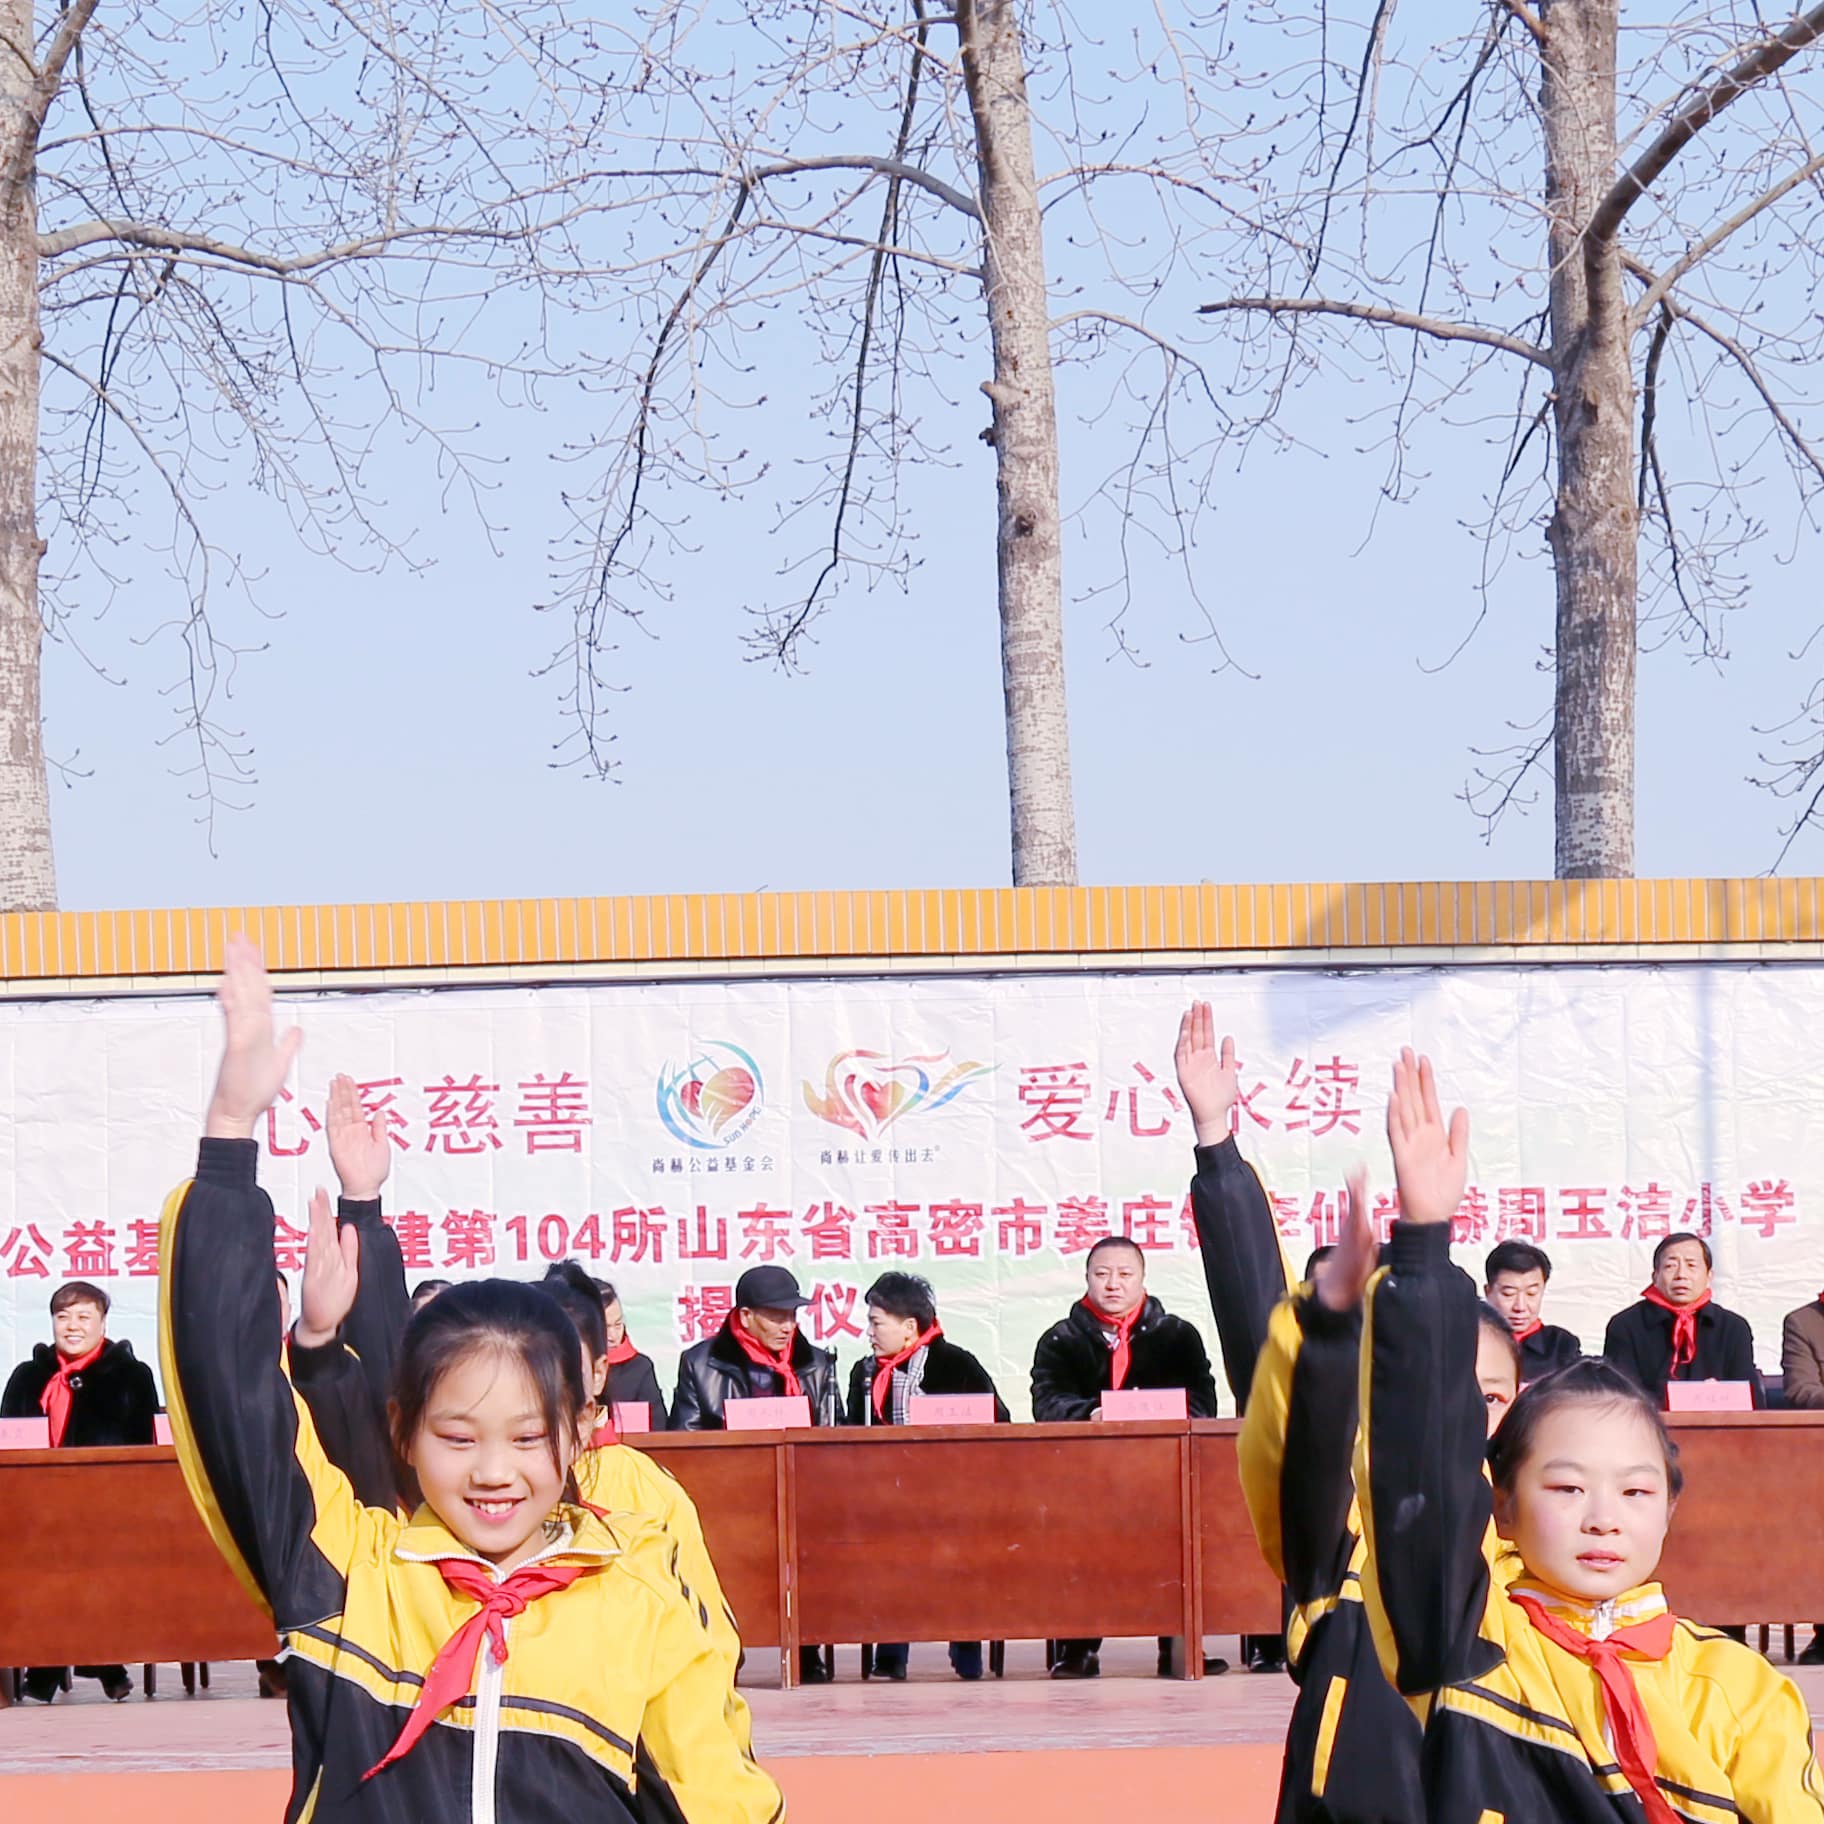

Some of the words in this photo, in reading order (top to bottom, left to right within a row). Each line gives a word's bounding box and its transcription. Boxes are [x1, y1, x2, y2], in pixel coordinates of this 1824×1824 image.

[652, 1156, 775, 1173] 尚赫公益基金会
